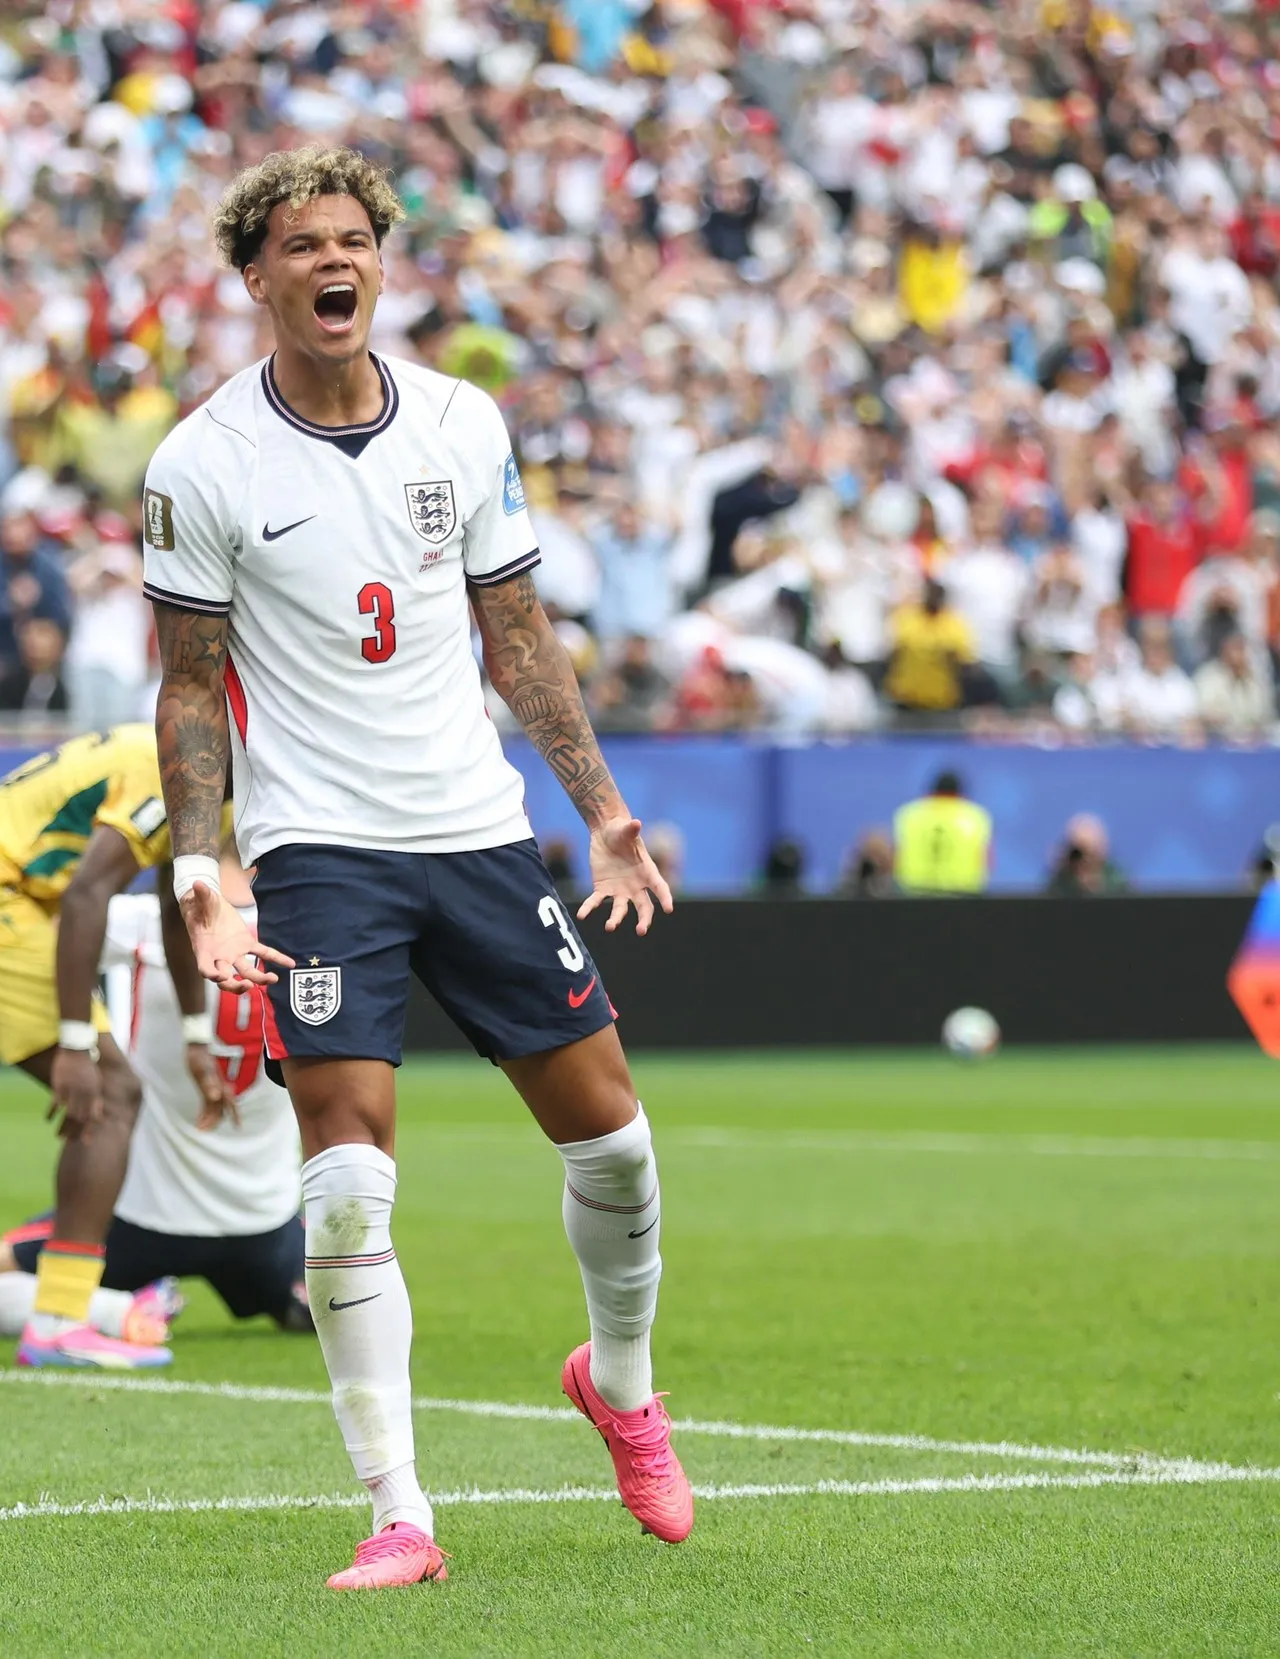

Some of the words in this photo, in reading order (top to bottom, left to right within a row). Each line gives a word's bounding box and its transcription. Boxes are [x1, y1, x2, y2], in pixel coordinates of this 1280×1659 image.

[357, 582, 396, 664] 3
[537, 895, 584, 973] 3
[215, 975, 265, 1097] 9
